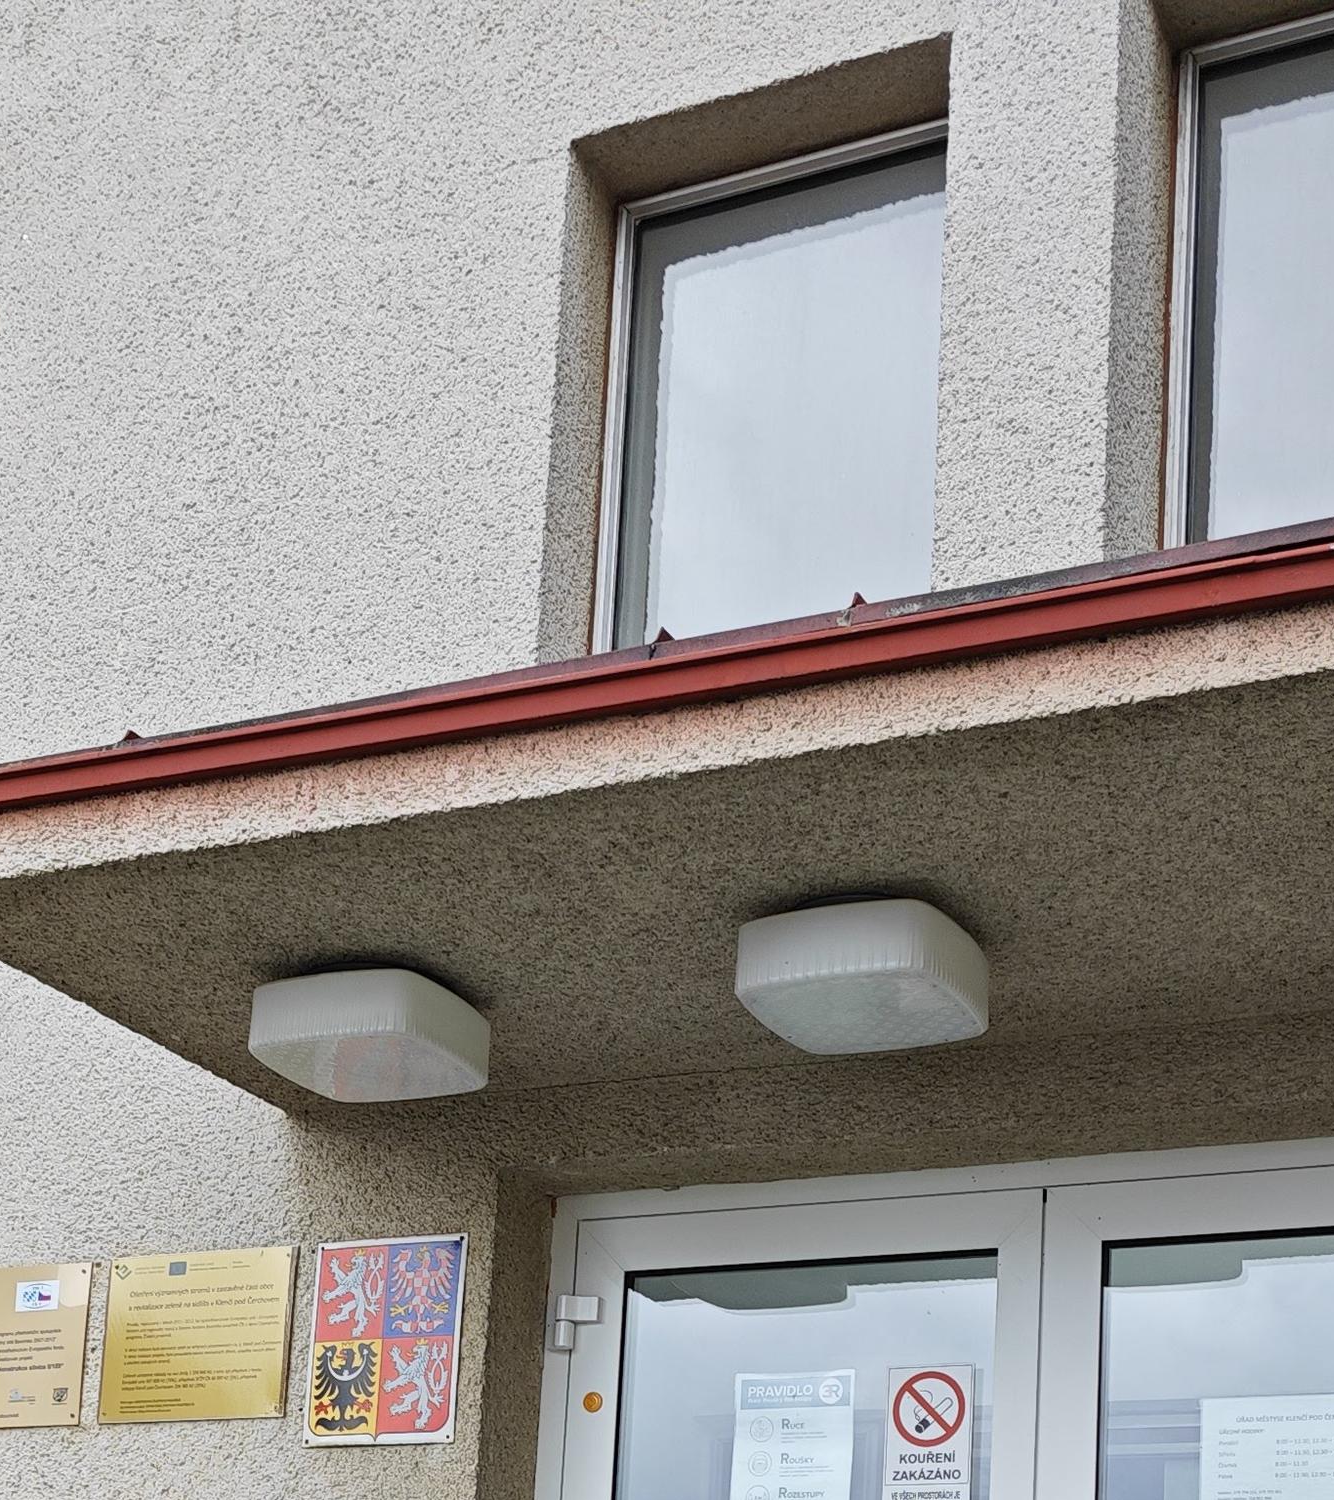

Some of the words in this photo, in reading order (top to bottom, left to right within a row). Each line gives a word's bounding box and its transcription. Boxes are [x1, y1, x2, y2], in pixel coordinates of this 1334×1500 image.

[747, 1384, 813, 1398] PRAVIDLO
[899, 1450, 956, 1464] KOUŘENÍ
[892, 1468, 961, 1481] ZAKÁZÁNO
